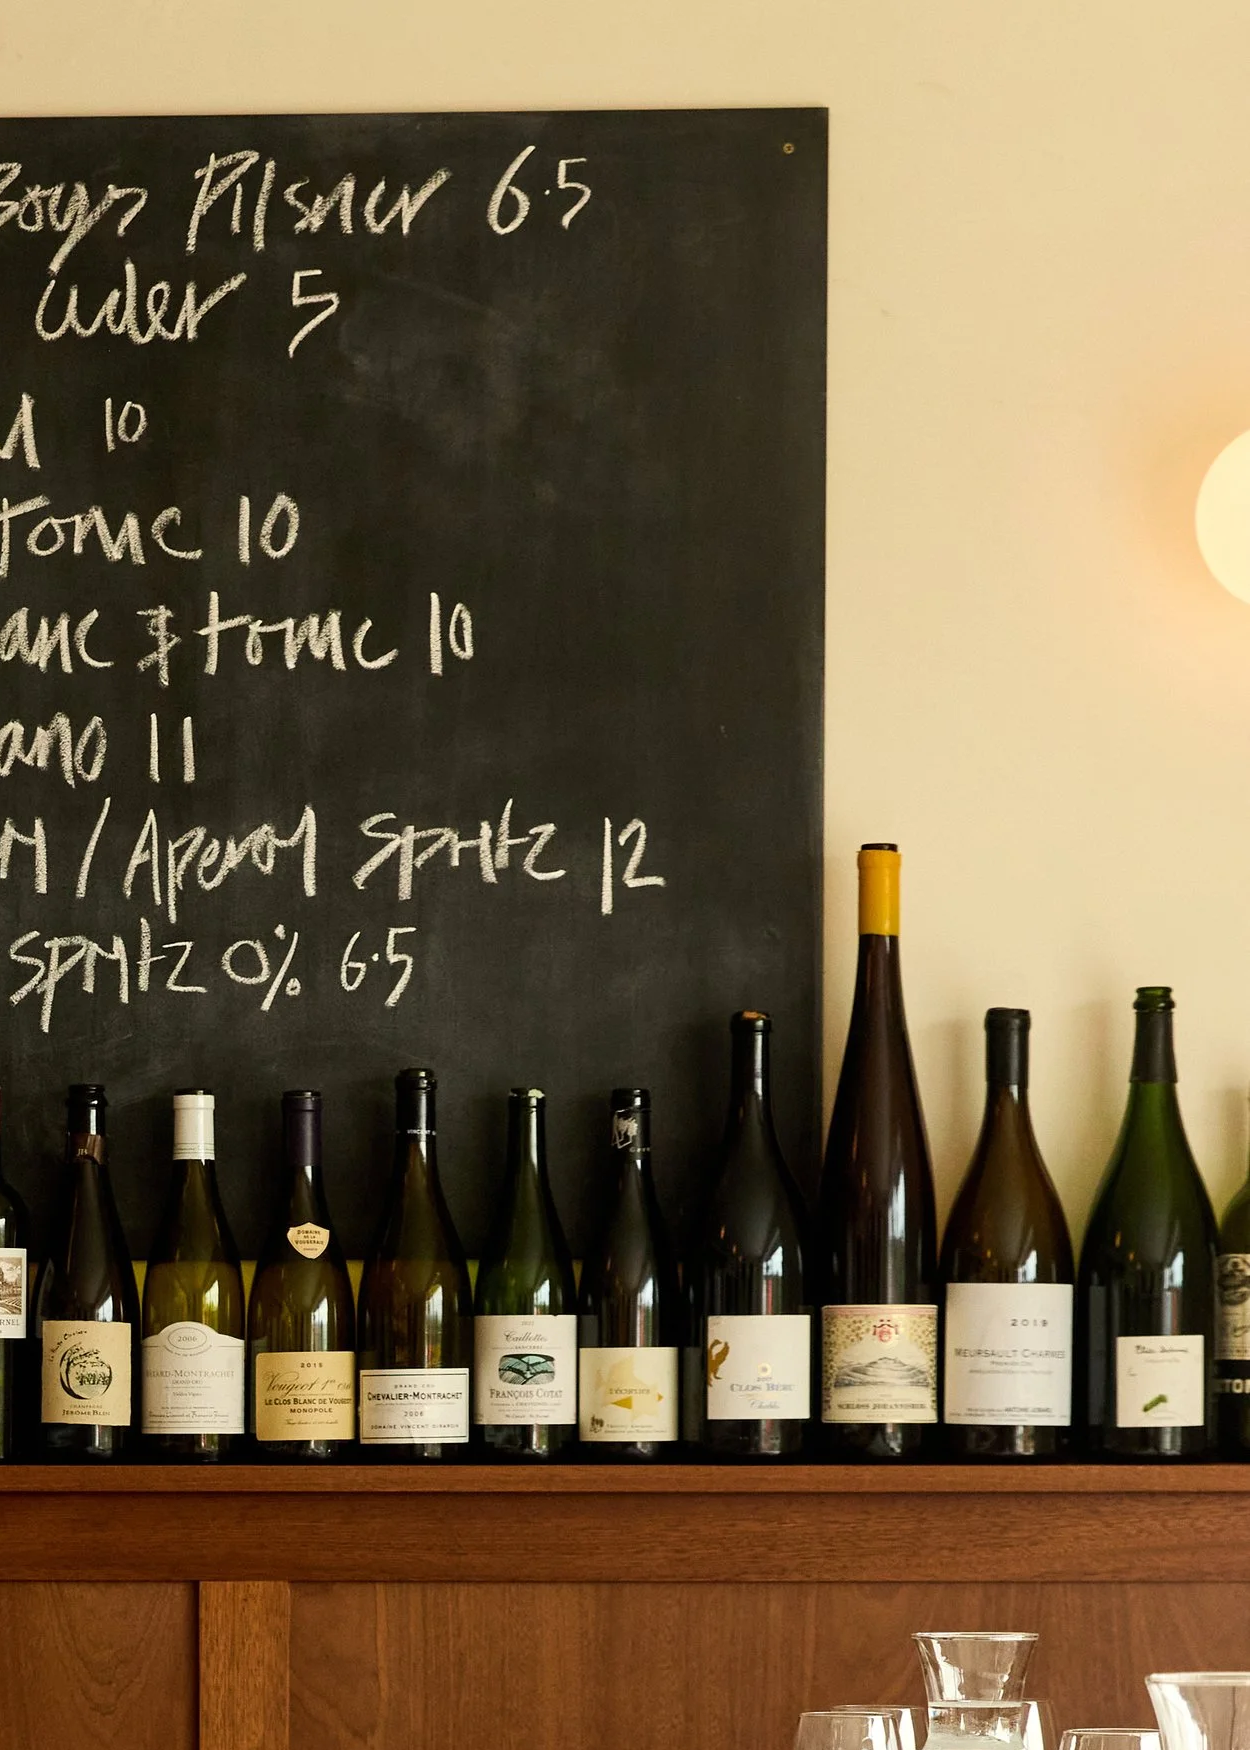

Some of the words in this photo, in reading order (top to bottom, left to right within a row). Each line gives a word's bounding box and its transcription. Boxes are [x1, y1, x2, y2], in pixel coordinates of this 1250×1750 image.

[186, 149, 452, 255] Pilsner
[292, 269, 340, 359] 5
[105, 397, 147, 452] 10
[239, 491, 301, 565] 10
[429, 591, 474, 677] 10
[150, 712, 197, 785] 11
[600, 816, 668, 917] 12
[293, 1397, 317, 1405] BLANC
[367, 1392, 463, 1401] CHEVALIER-MONTRACHET
